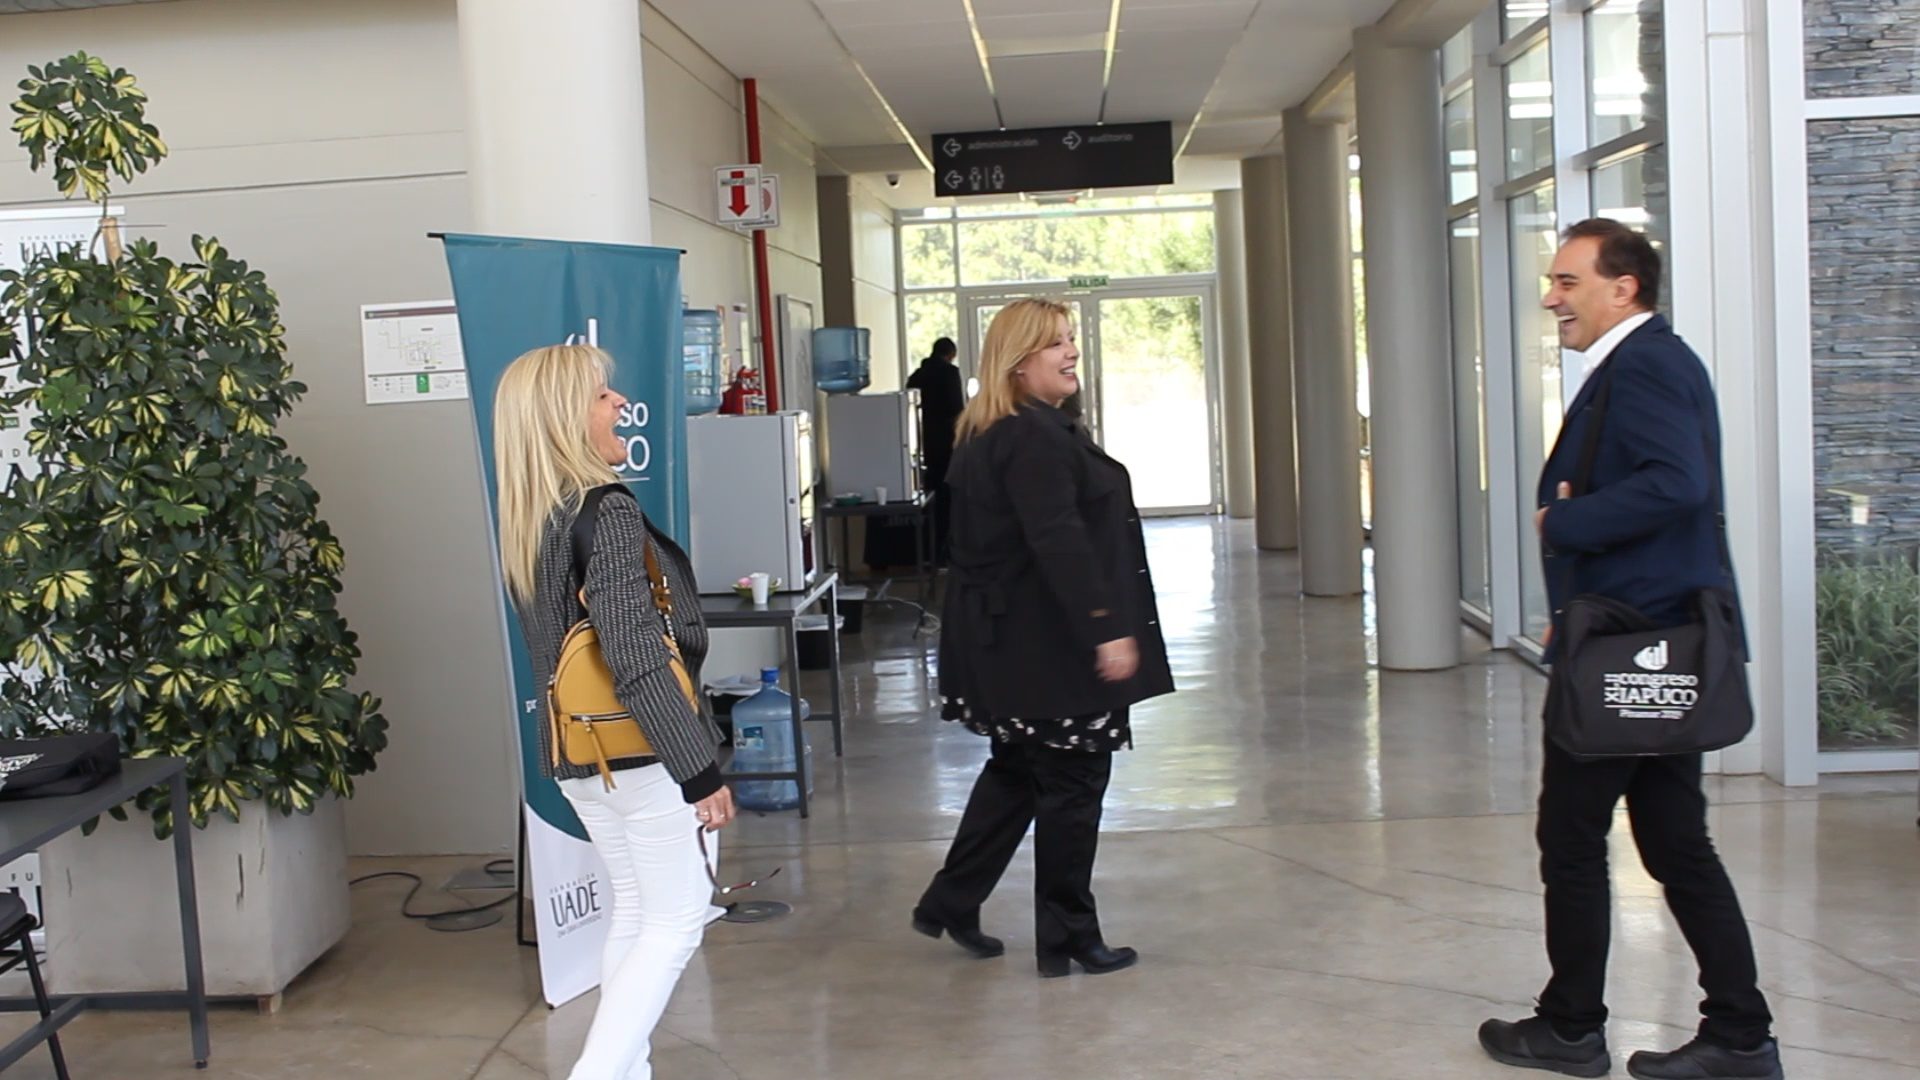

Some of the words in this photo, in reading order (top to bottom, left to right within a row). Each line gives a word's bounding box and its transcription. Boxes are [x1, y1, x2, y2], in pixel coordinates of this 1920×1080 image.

[1070, 278, 1107, 288] SALIDA
[1620, 673, 1699, 688] congreso
[1619, 687, 1699, 706] IAPUCO
[550, 880, 602, 928] UADE
